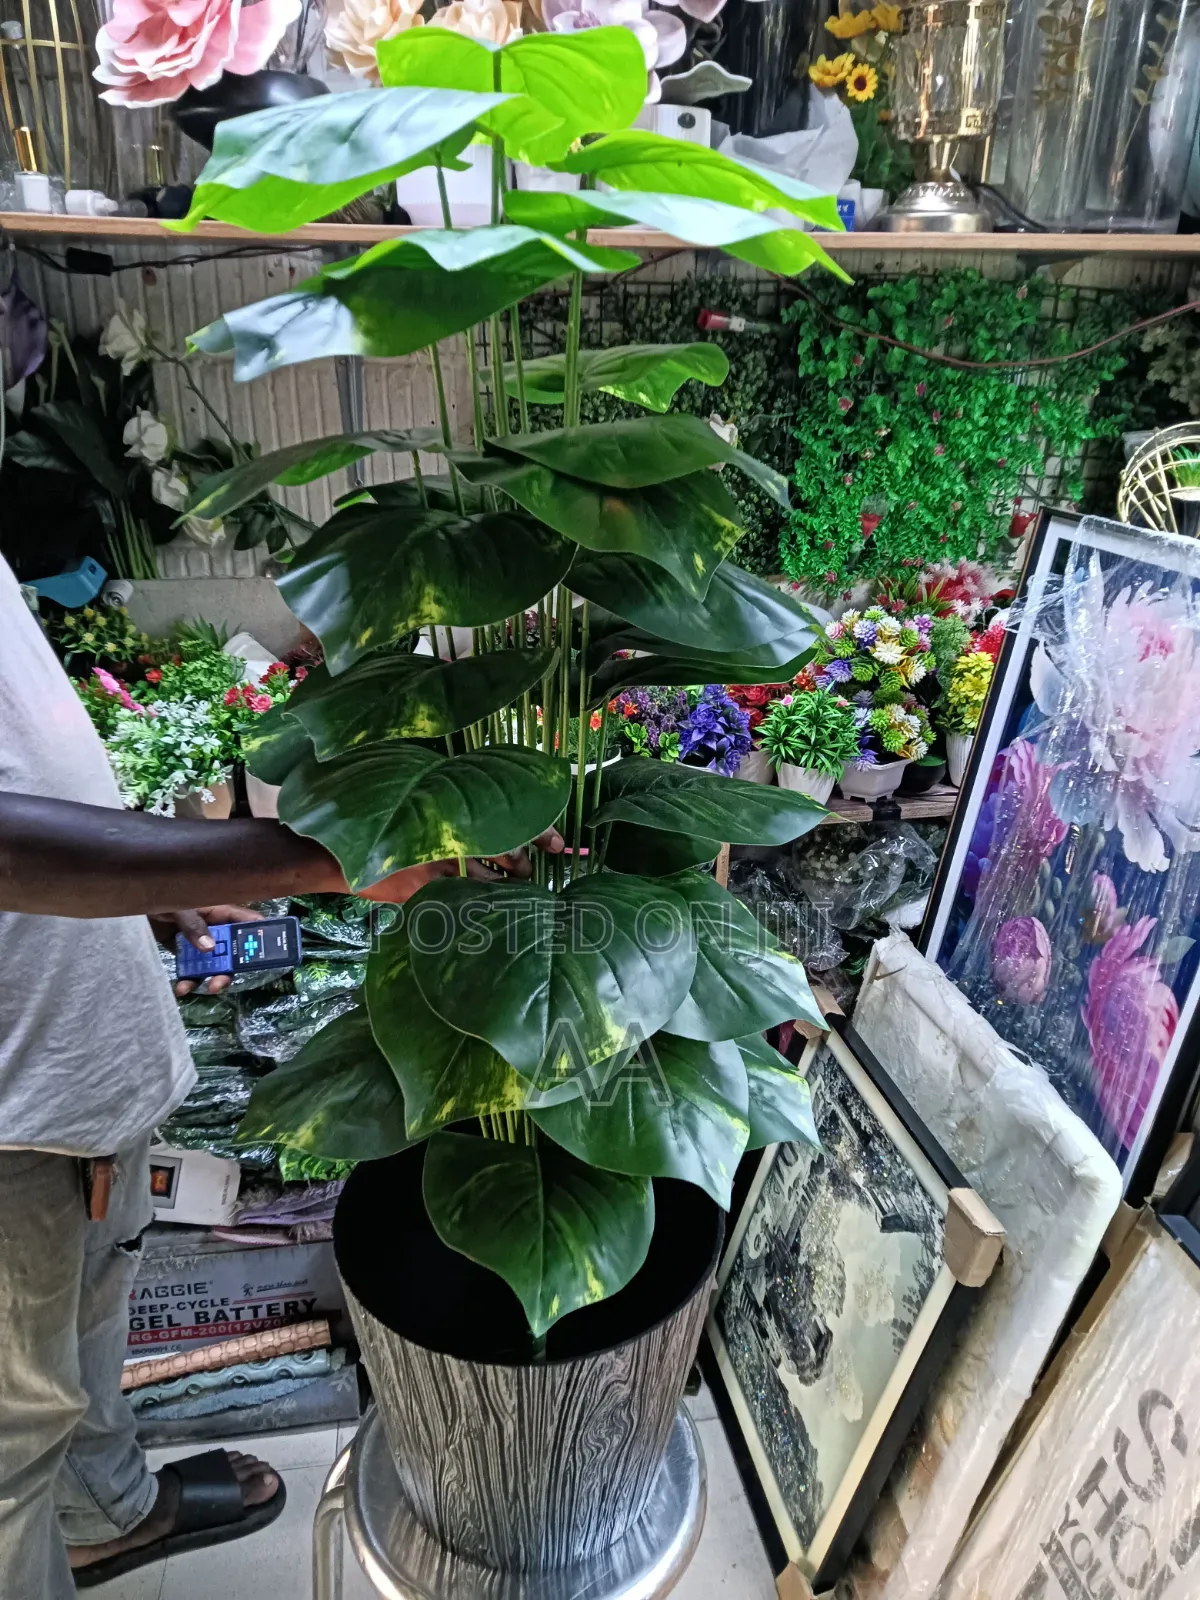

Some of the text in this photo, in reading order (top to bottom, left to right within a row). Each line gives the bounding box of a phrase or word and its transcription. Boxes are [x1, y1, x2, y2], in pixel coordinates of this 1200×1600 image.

[128, 1297, 230, 1316] DEEP-CYCLE
[128, 1298, 317, 1332] GEL BATTERY
